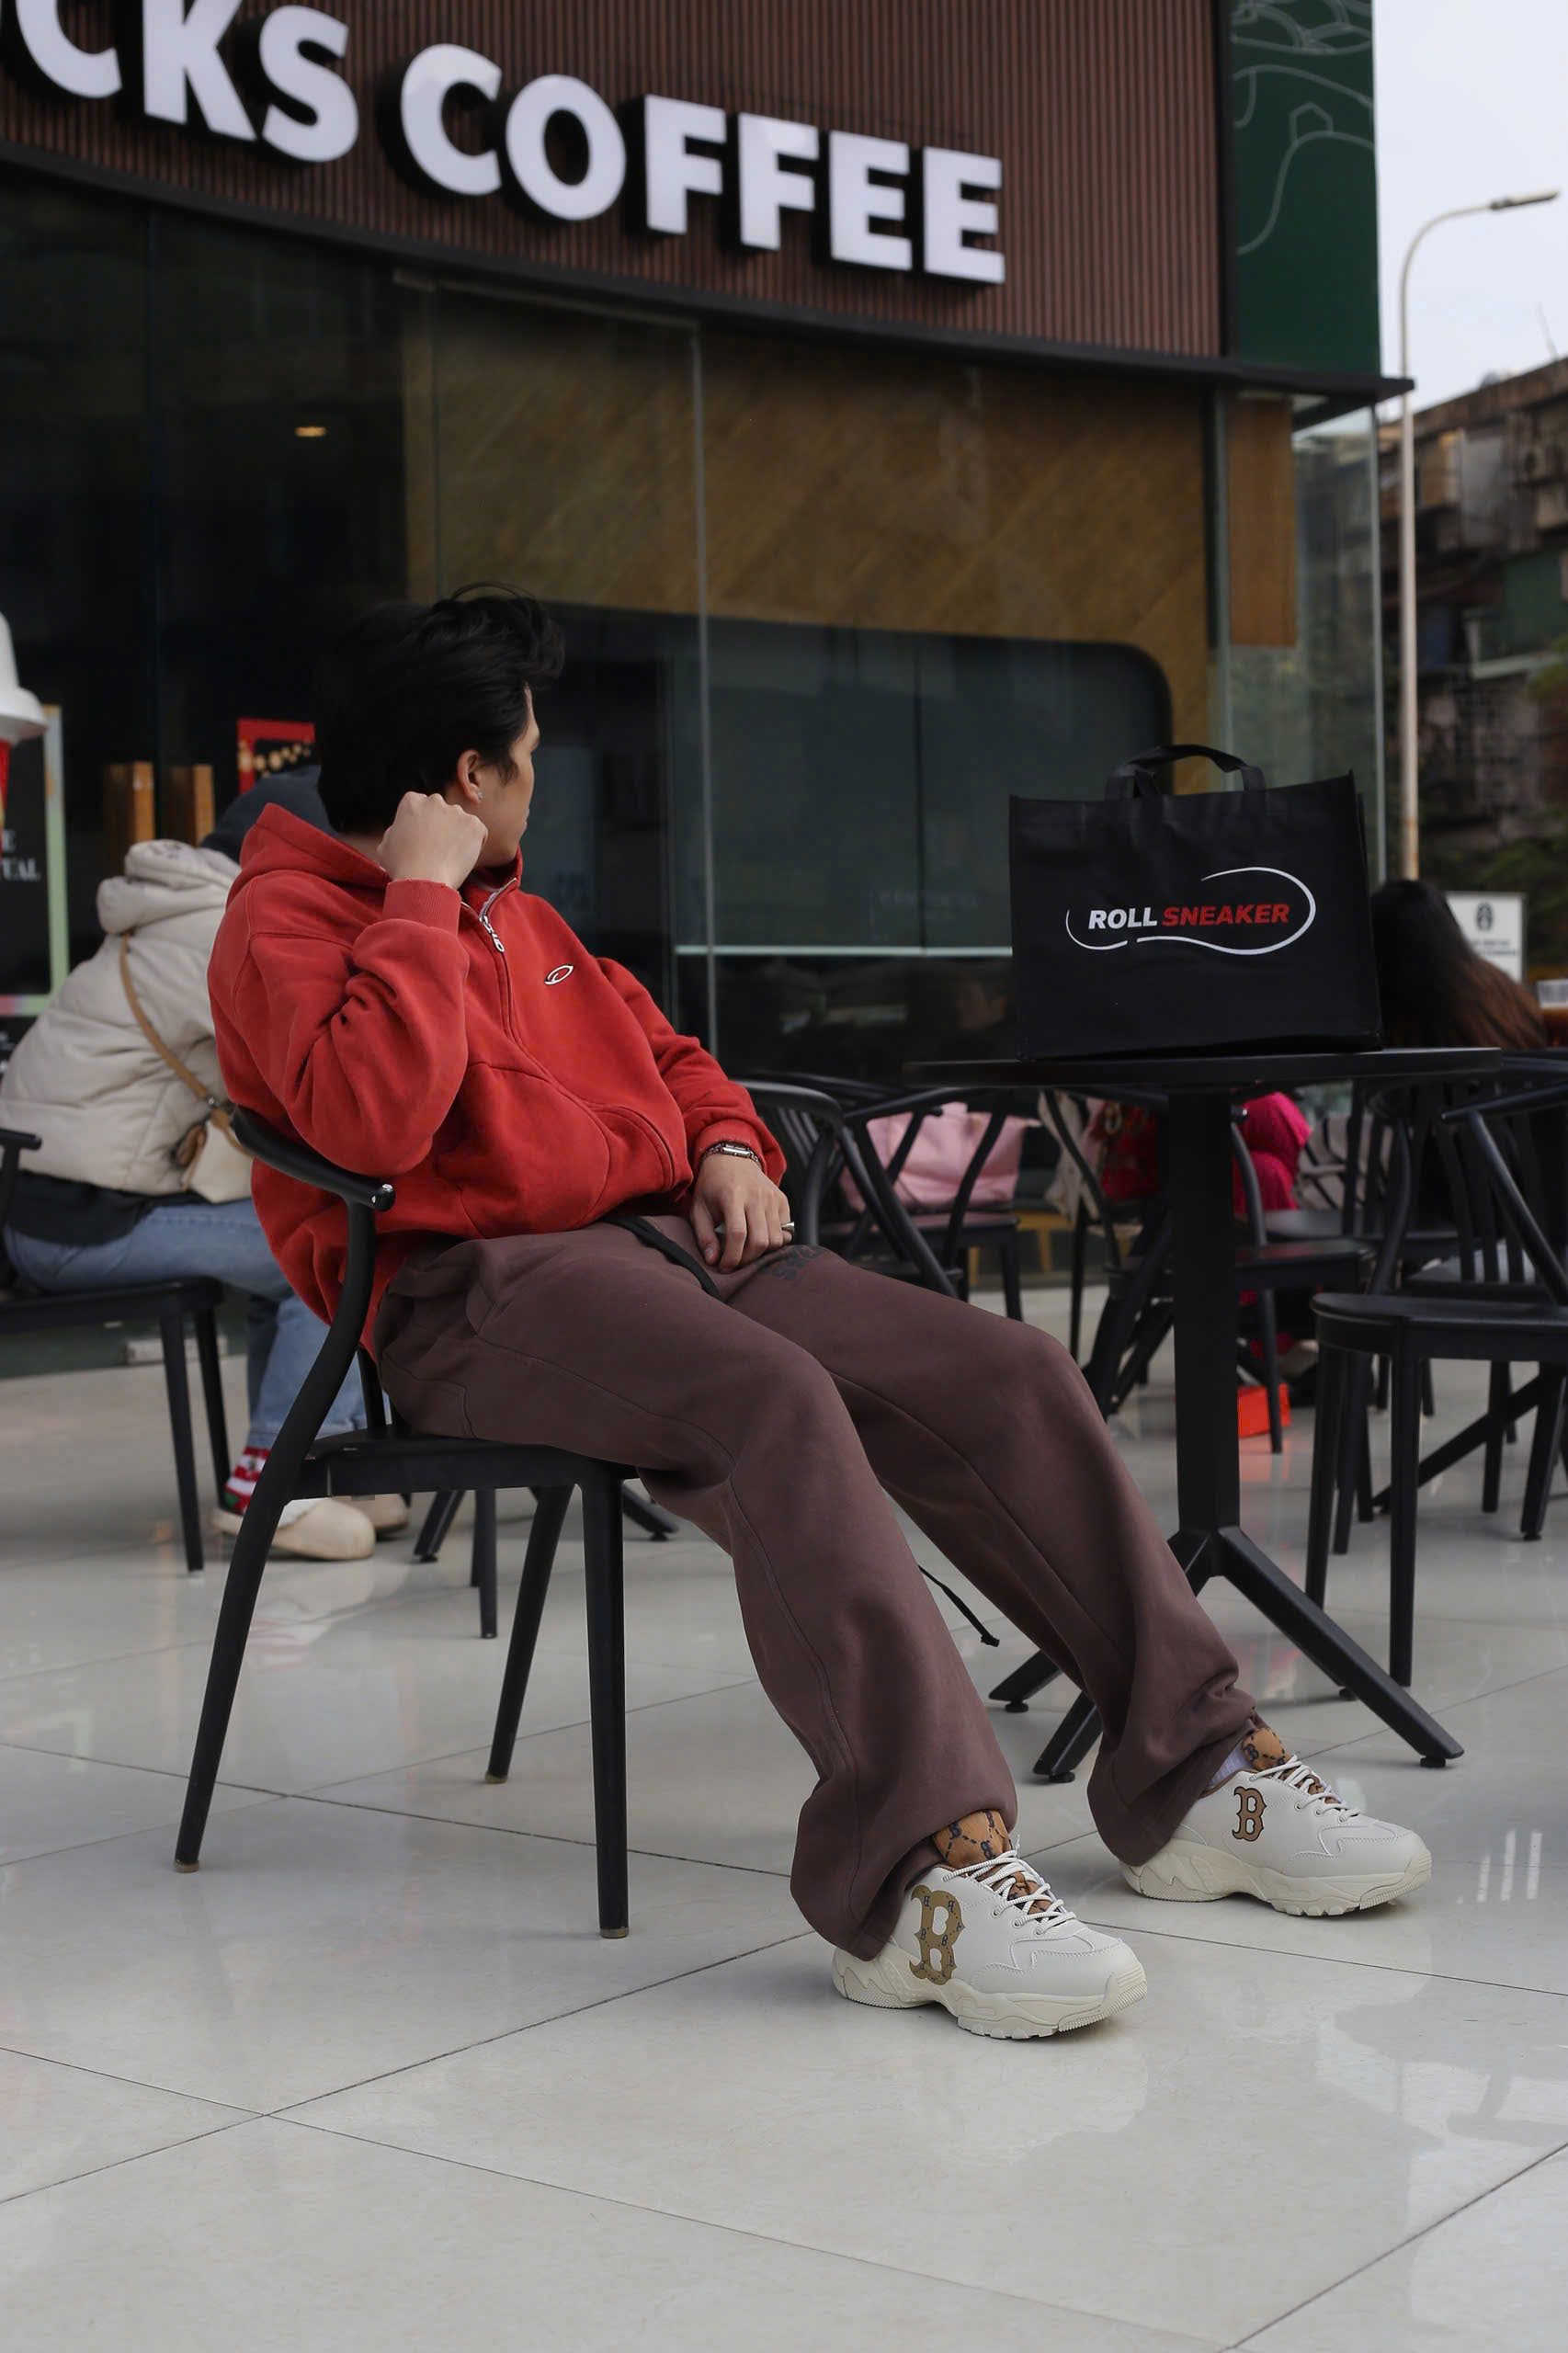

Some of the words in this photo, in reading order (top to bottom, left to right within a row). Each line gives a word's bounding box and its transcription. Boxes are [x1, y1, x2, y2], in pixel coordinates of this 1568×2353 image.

[401, 42, 1006, 284] COFFEE
[1088, 905, 1158, 929] ROLL
[1161, 904, 1290, 926] SNEAKER
[1232, 1785, 1267, 1842] B
[909, 1884, 966, 1985] B
